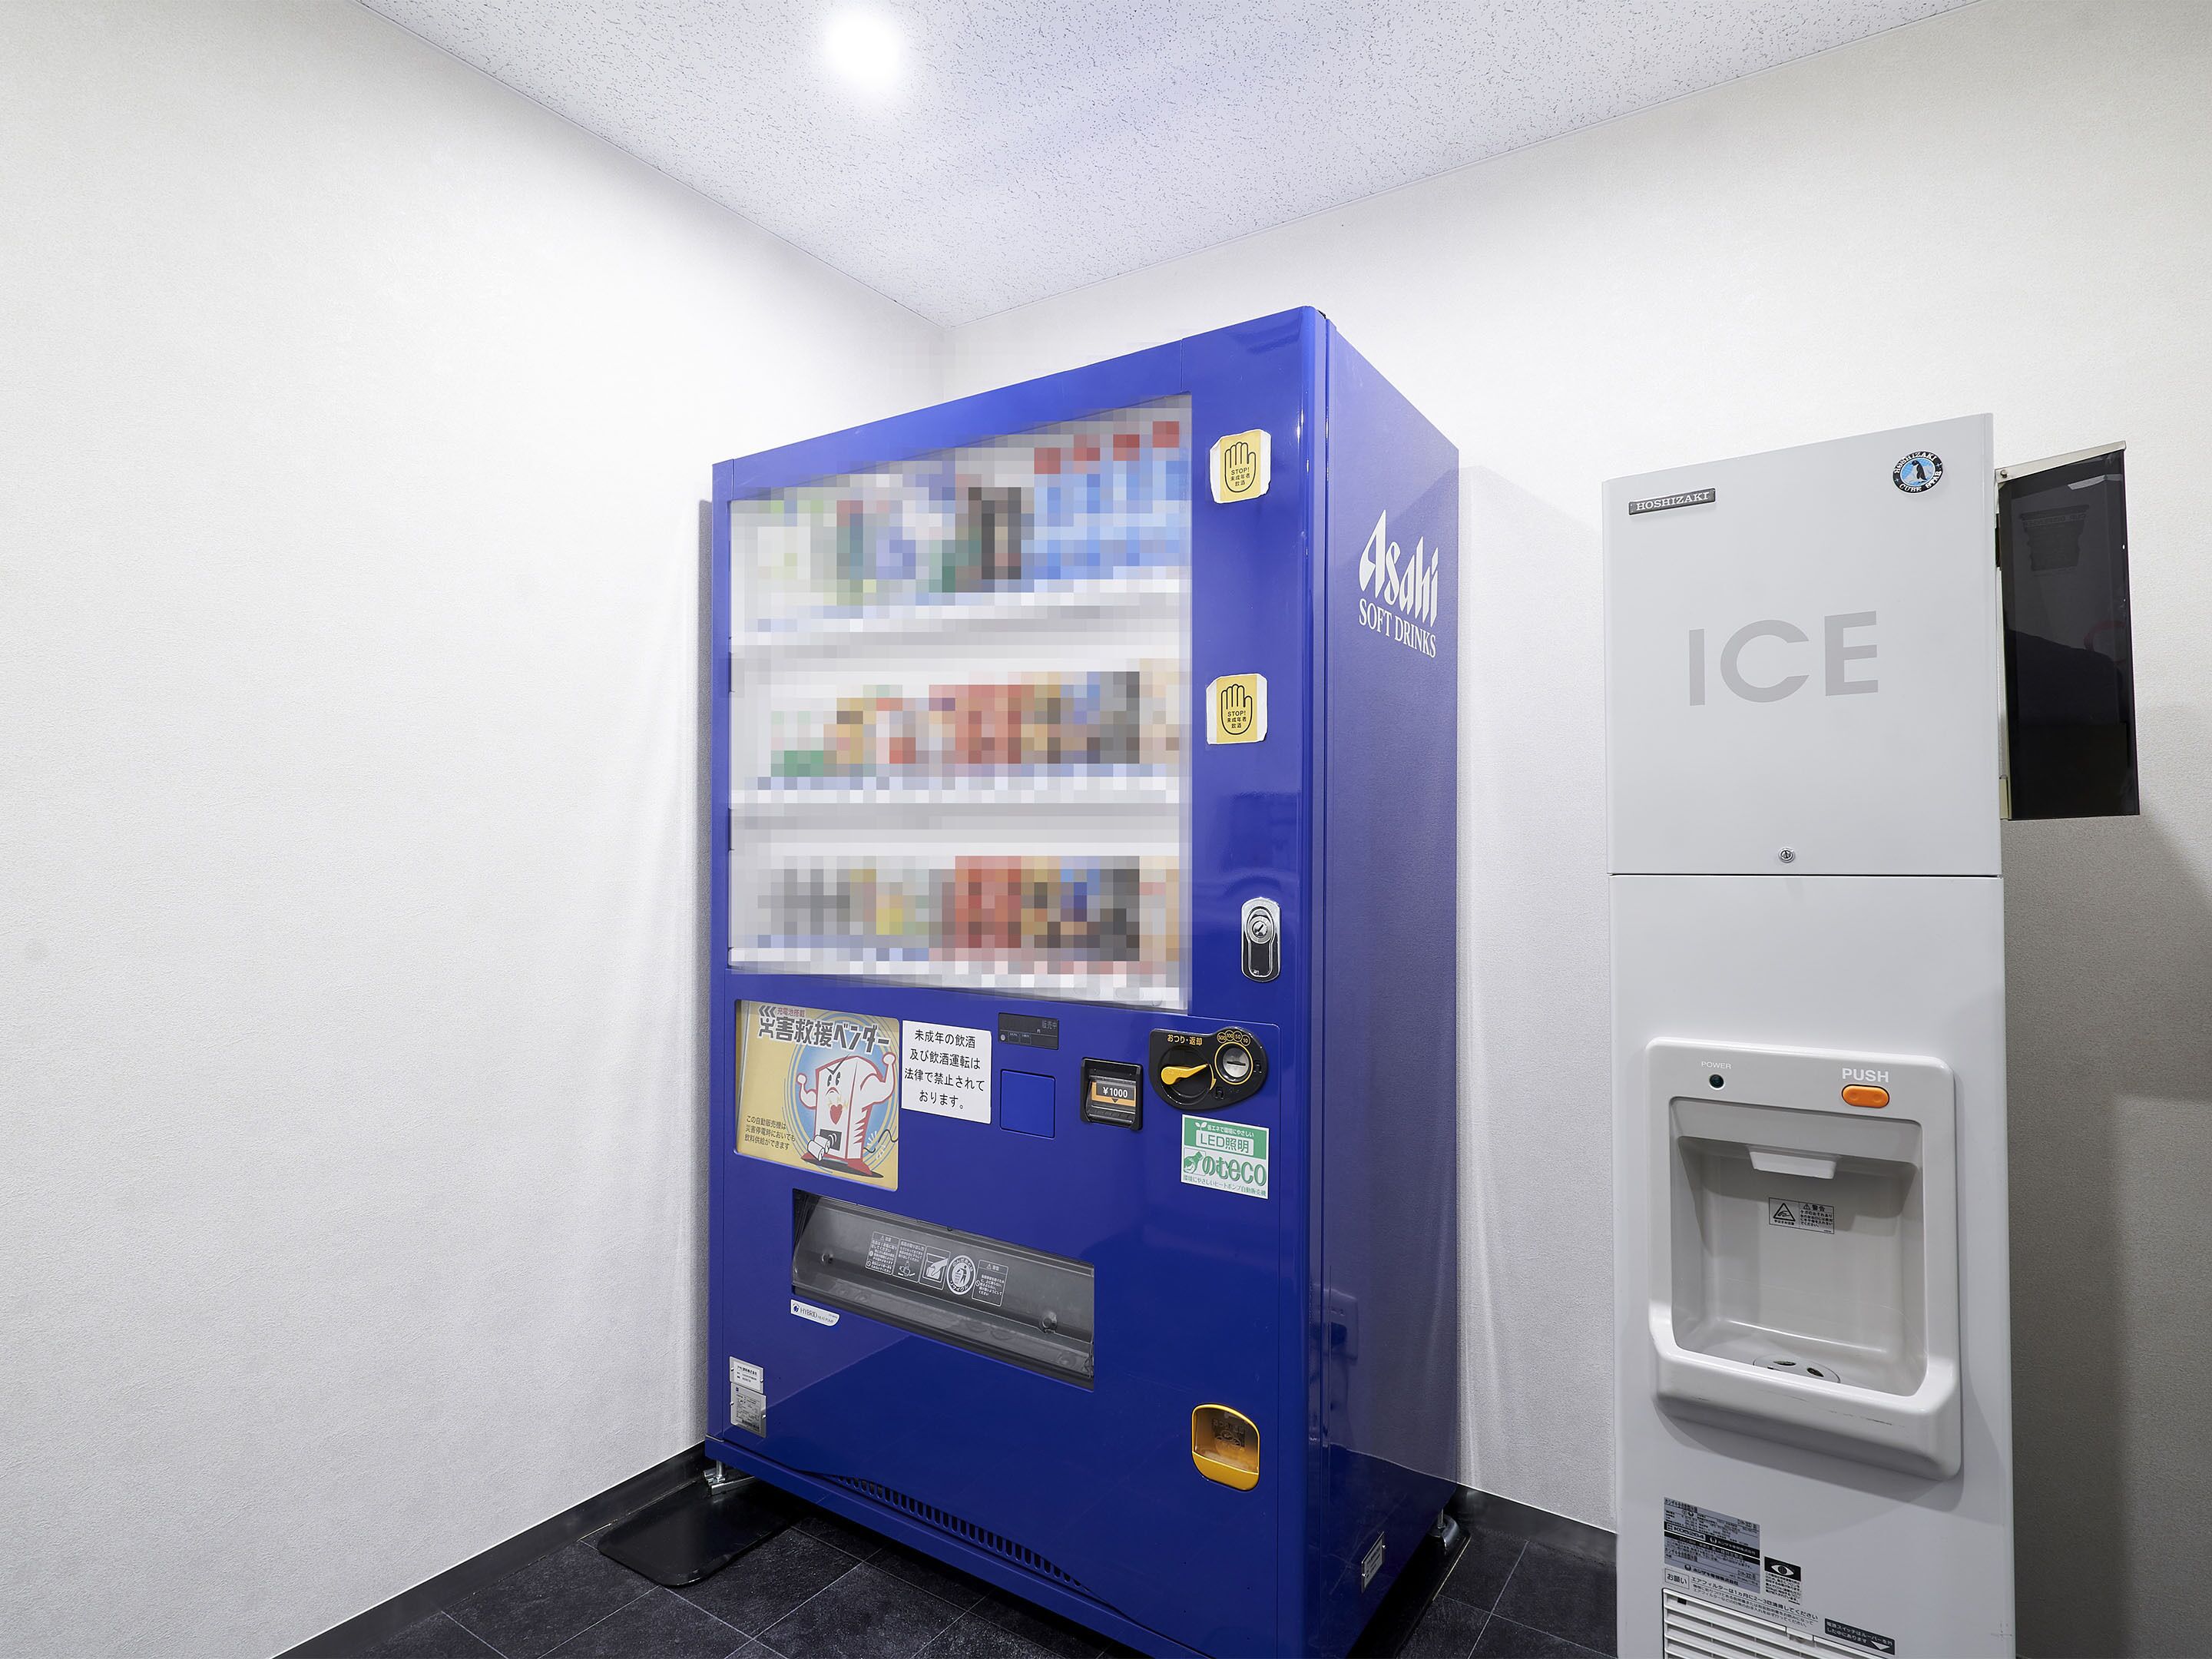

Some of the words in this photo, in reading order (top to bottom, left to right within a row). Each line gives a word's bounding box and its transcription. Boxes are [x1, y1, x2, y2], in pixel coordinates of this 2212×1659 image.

[1231, 467, 1250, 475] STOP!
[1893, 452, 1937, 474] HOSHIZAKI
[1899, 483, 1922, 492] CUBE
[1926, 471, 1942, 488] STAR
[1636, 492, 1710, 511] HOSHIZAKI
[1359, 509, 1439, 628] Asahi
[1359, 598, 1392, 637] SOFT
[1394, 615, 1436, 658] DRINKS
[1689, 611, 1879, 706] ICE
[758, 1005, 889, 1053] 災害救援ベンダー
[915, 1029, 975, 1048] 未成年の飲酒
[1167, 1034, 1203, 1046] おつり・返却
[909, 1048, 981, 1070] 及び飲酒運転は
[1701, 1061, 1731, 1069] POWER
[904, 1068, 985, 1091] 法律で禁止されて
[1842, 1068, 1889, 1083] PUSH
[919, 1090, 963, 1110] おります。
[1103, 1087, 1128, 1098] ¥1000
[746, 1115, 786, 1130] この自動販売機は
[1200, 1133, 1250, 1154] LED照明
[800, 1307, 818, 1318] HYBRID
[1667, 1573, 1687, 1584] お願い
